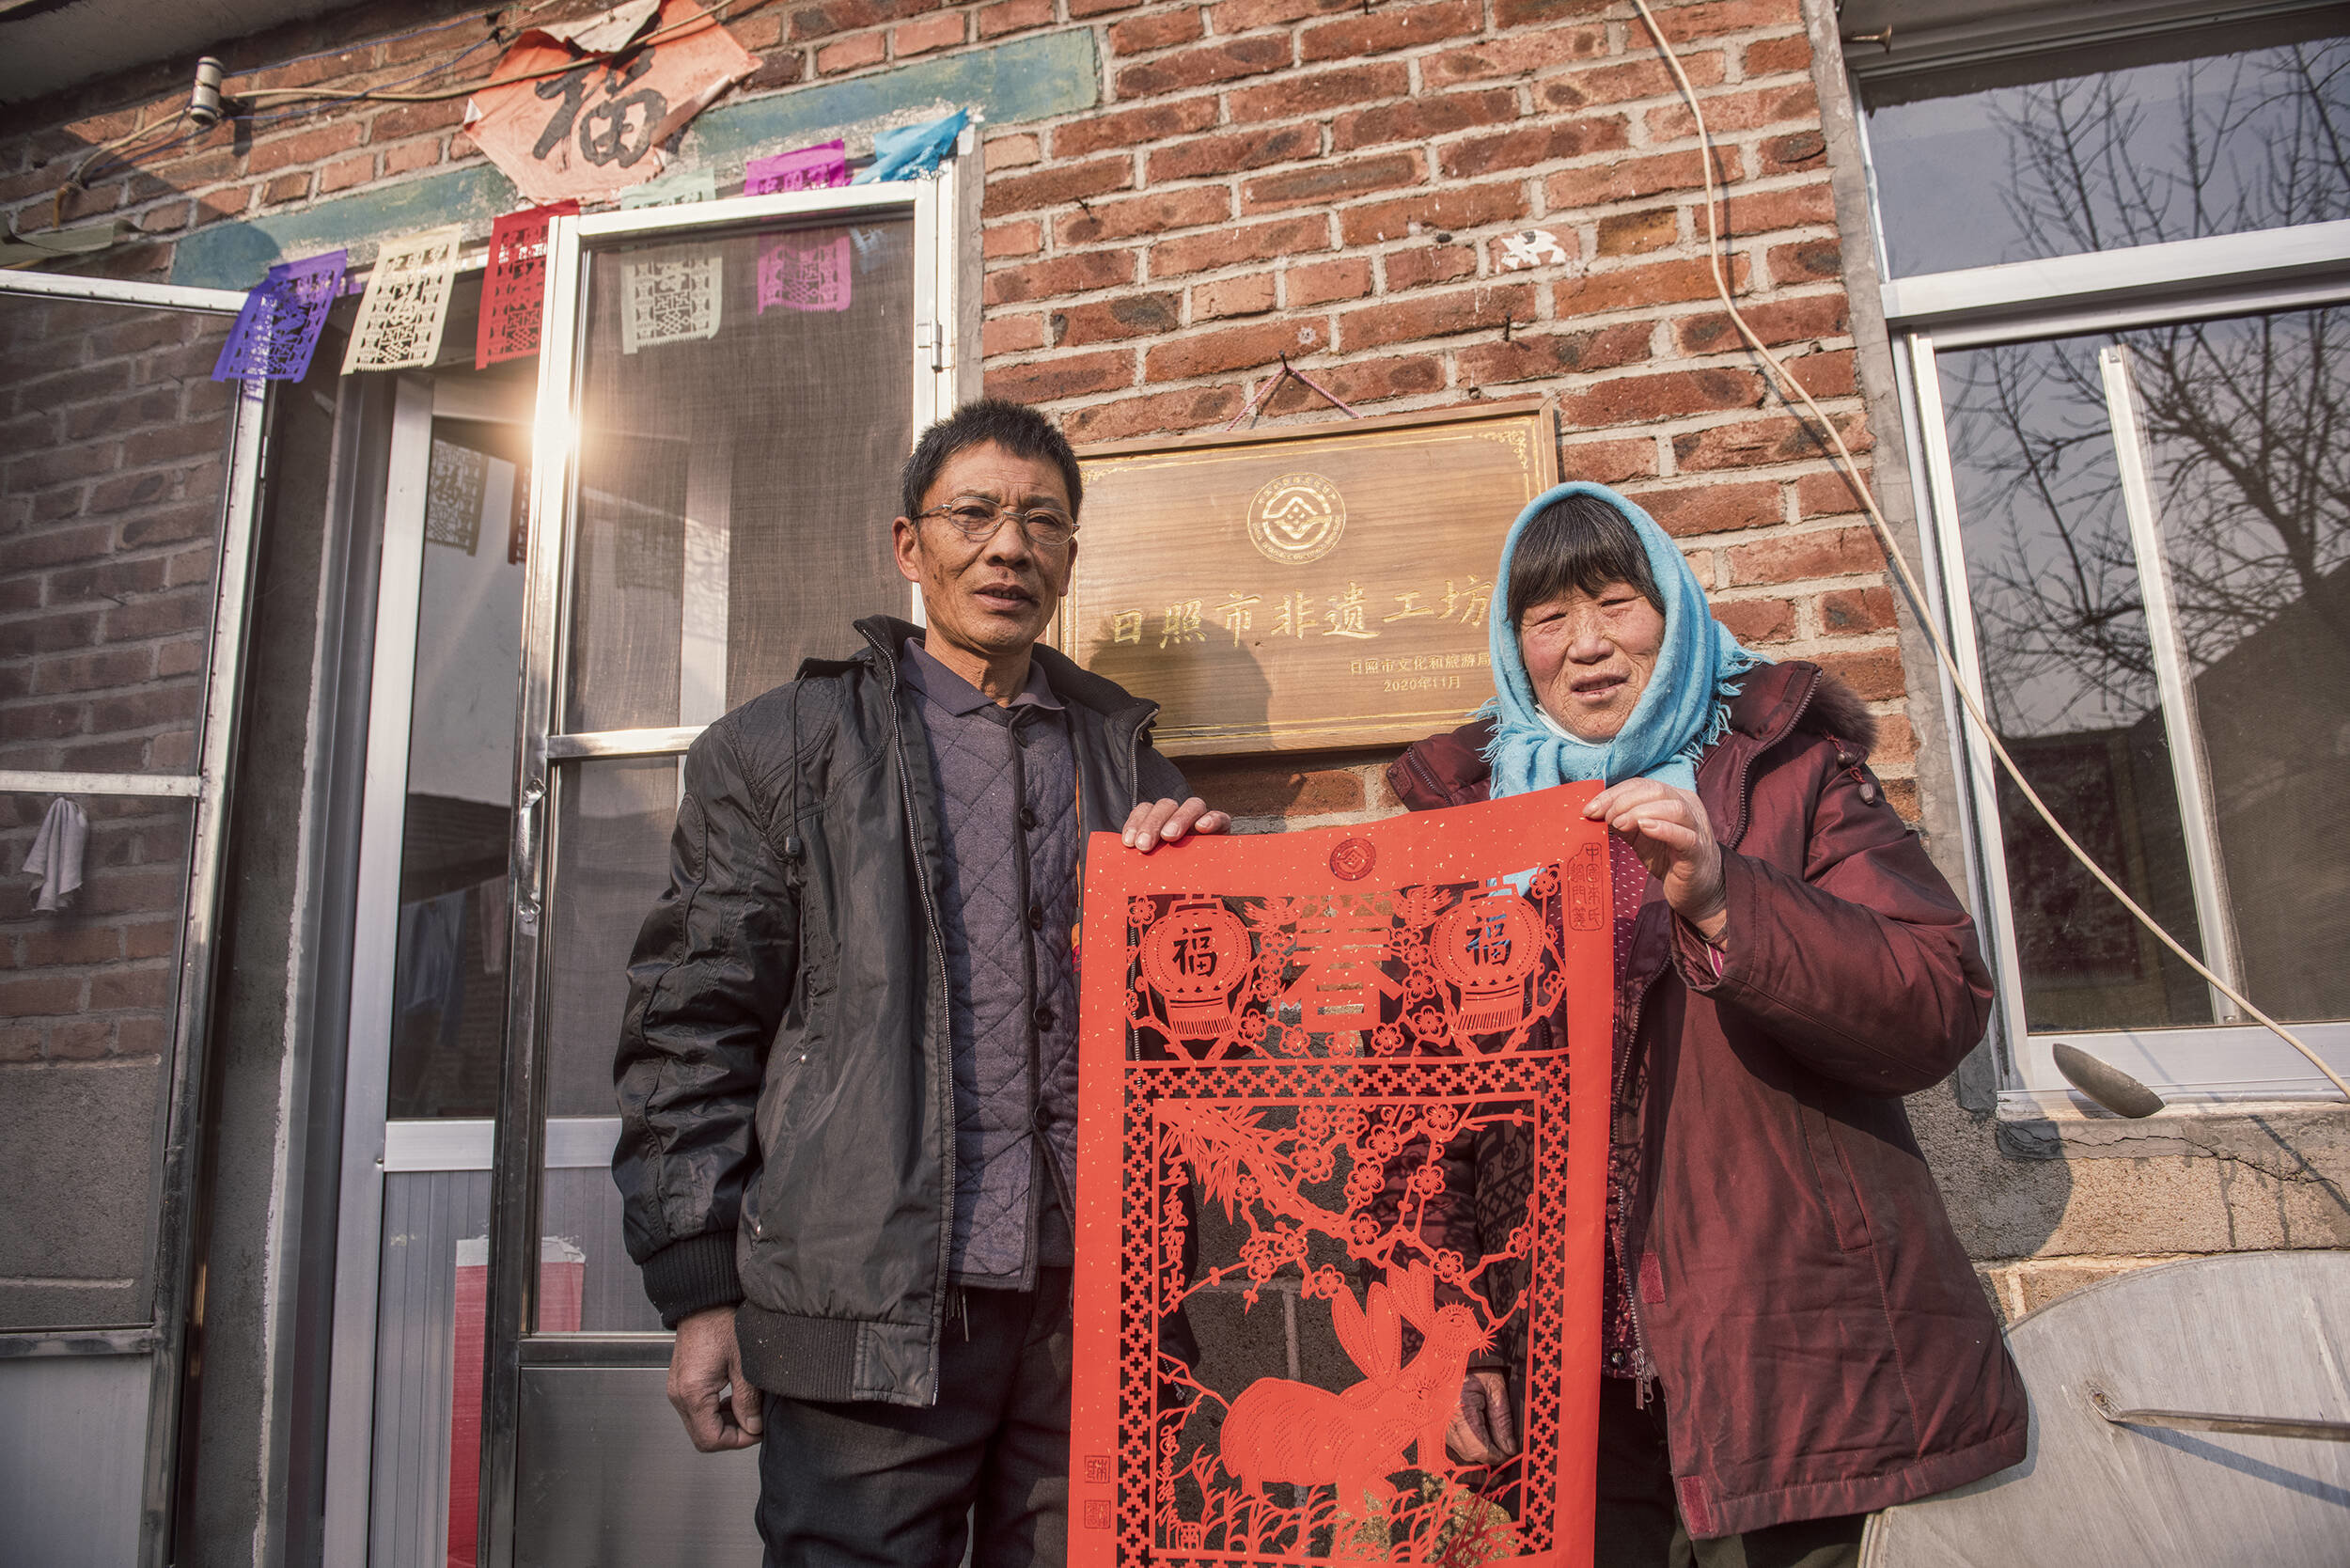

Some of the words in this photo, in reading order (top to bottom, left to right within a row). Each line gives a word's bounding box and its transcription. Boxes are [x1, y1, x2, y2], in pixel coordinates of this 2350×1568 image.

[534, 47, 667, 168] 福
[1113, 574, 1494, 650] 日照市非遗工坊
[1350, 653, 1491, 675] 日照市文化和旅游局
[1384, 676, 1461, 693] 2020年11月
[1173, 927, 1217, 977] 福
[1466, 914, 1512, 966] 福
